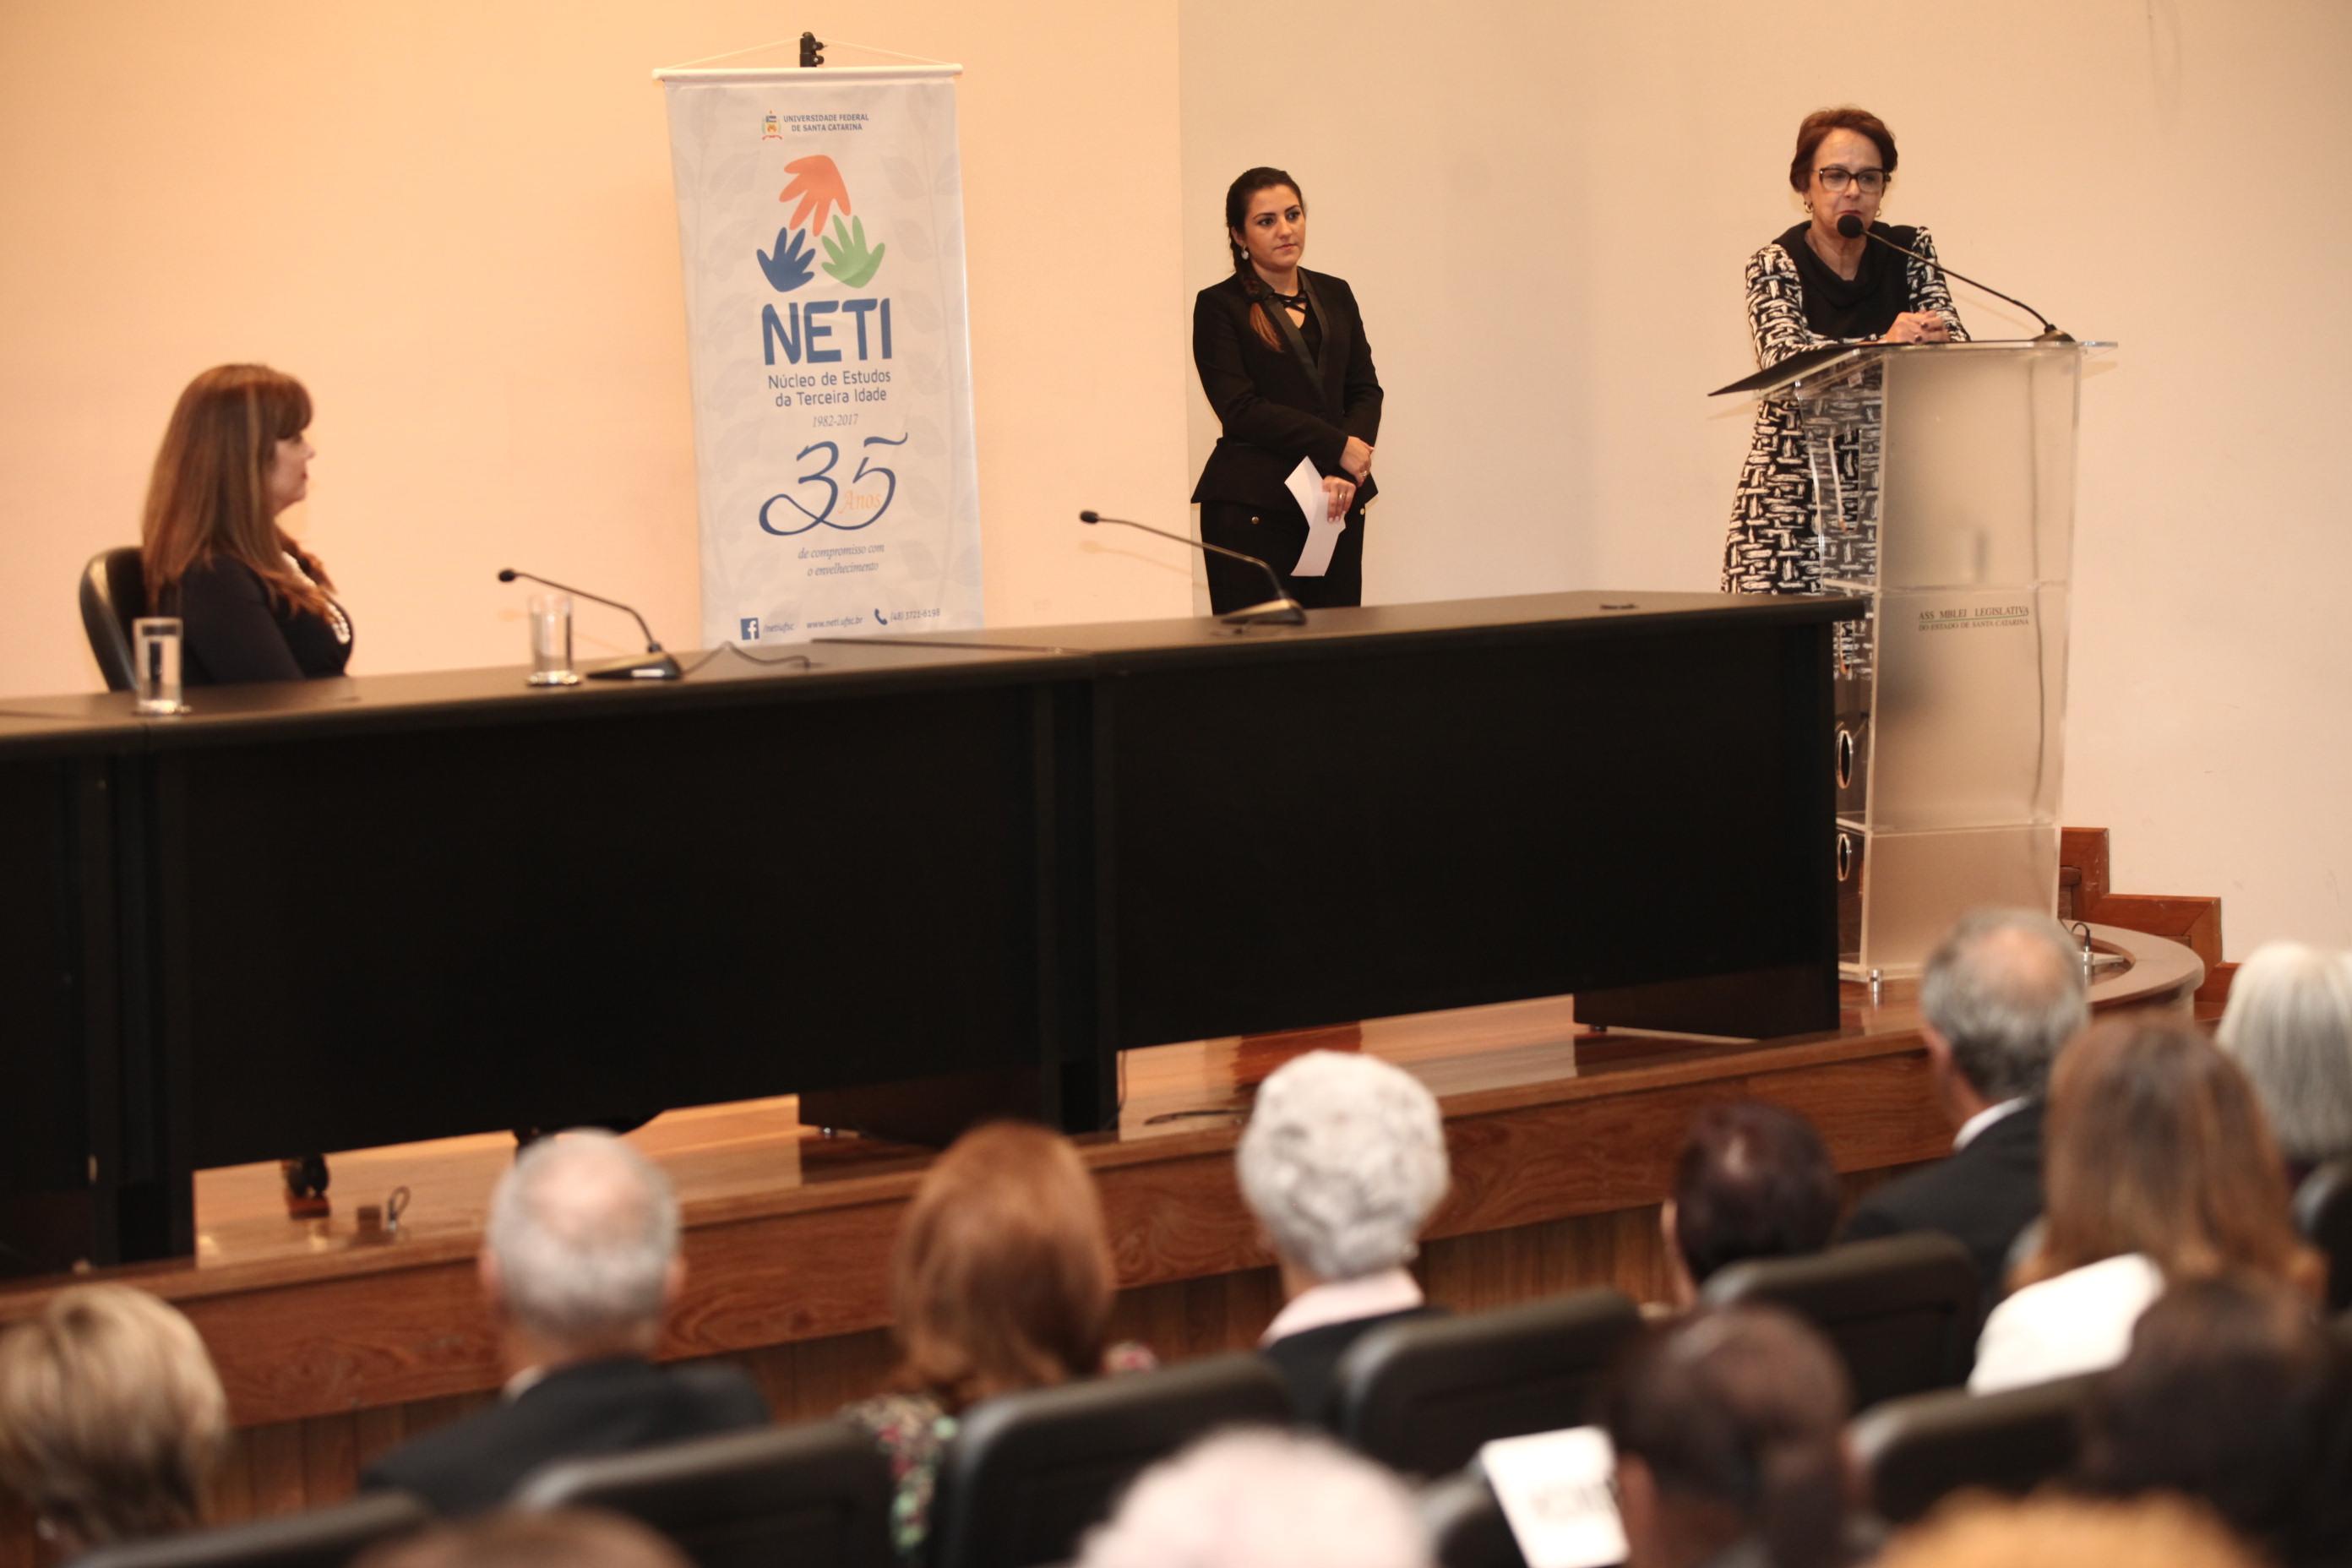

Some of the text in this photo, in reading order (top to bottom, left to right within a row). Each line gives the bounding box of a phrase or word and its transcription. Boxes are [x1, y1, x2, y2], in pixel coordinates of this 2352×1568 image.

[783, 113, 869, 122] UNIVERSIDADE FEDERAL
[761, 297, 892, 366] NETI
[768, 369, 891, 389] Núcleo de Estudos
[776, 387, 887, 407] da Terceira Idade
[812, 413, 859, 427] 1982-2017
[759, 432, 908, 536] 35
[838, 490, 882, 514] Anos
[798, 543, 885, 560] de compromisso com
[807, 561, 879, 576] o envelhecimento
[1974, 606, 2029, 618] LEGISLATIVA
[806, 616, 863, 629] www.neti.ufsc.br
[1930, 623, 1959, 631] ESTADO
[1960, 621, 1969, 629] DE
[1995, 618, 2029, 627] CATARINA
